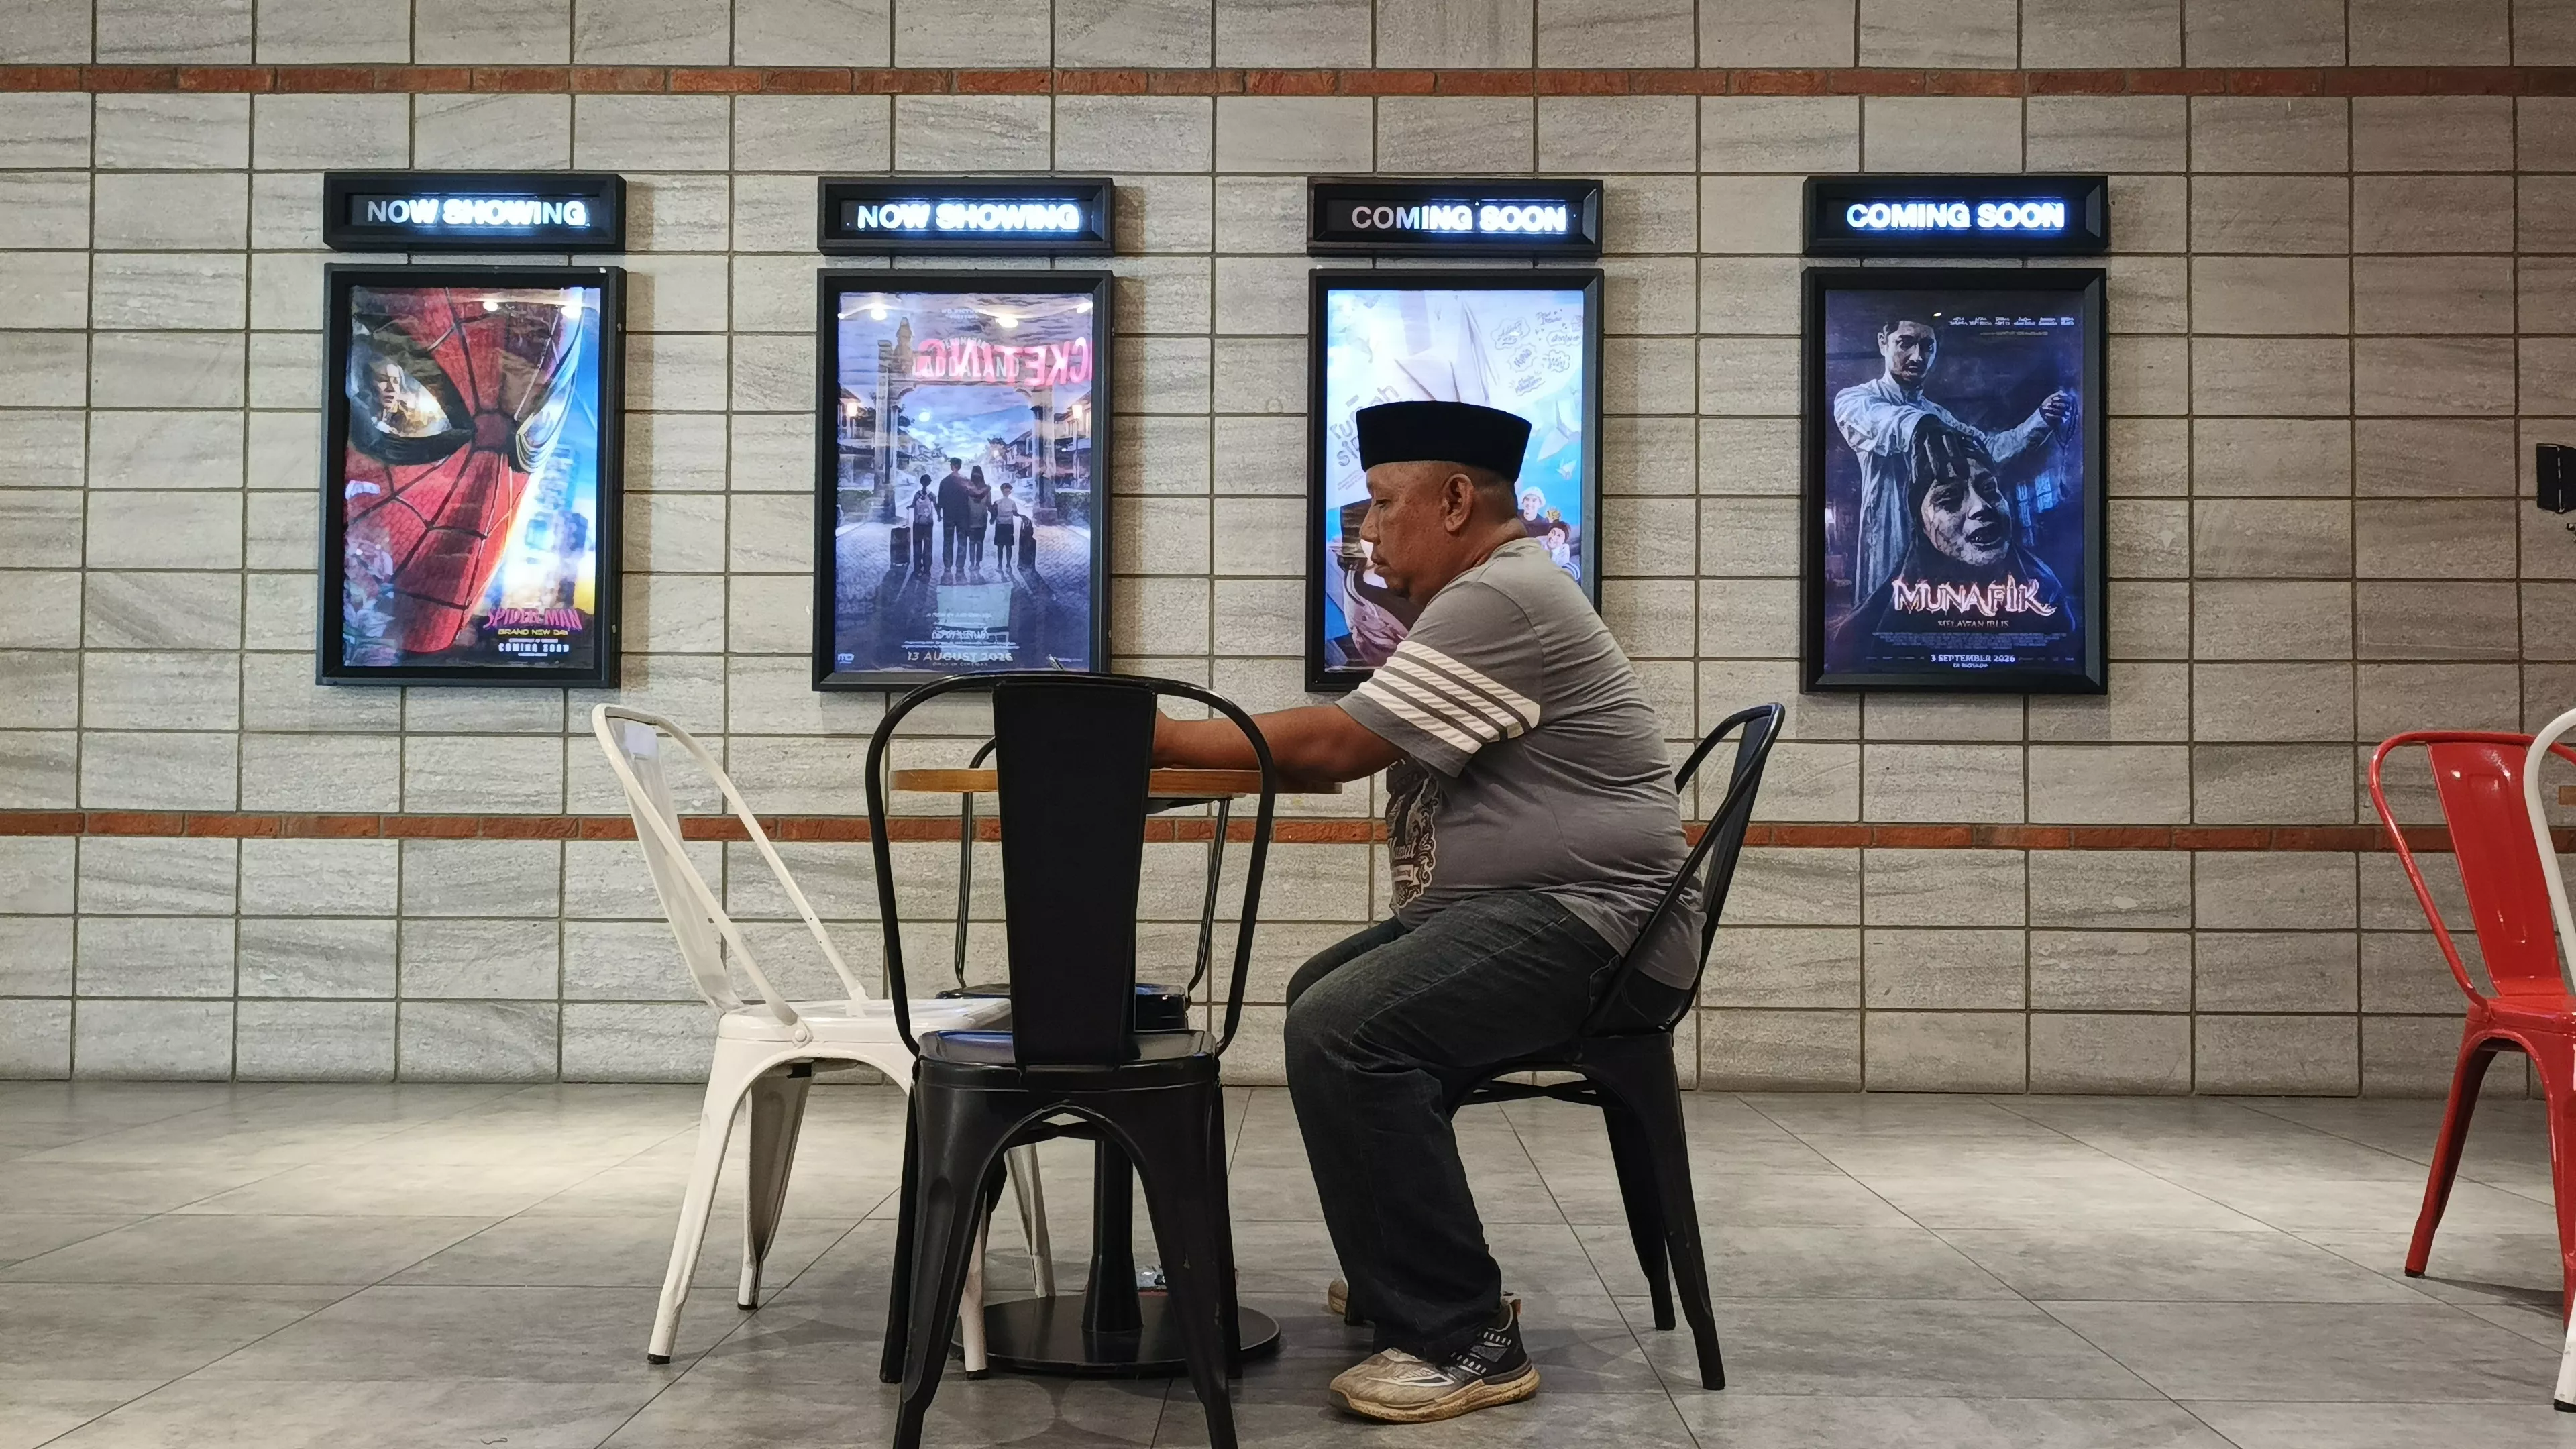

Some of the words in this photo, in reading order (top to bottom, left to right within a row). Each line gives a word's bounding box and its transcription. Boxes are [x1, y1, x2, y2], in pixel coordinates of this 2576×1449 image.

[368, 199, 438, 223] NOW
[443, 199, 587, 225] SHOWING
[857, 203, 930, 229] NOW
[936, 203, 1079, 229] SHOWING
[1352, 205, 1472, 230] COMING
[1479, 205, 1566, 231] SOON
[1847, 203, 1970, 228] COMING
[1977, 203, 2065, 228] SOON
[912, 355, 1020, 377] LADDALAND
[1892, 575, 2057, 617] MUNAFIK
[498, 643, 538, 652] COMING
[543, 644, 570, 653] SOON
[908, 651, 920, 661] 13
[923, 652, 978, 661] AUGUST
[981, 653, 1013, 661] 2026
[1994, 655, 2015, 663] 2026
